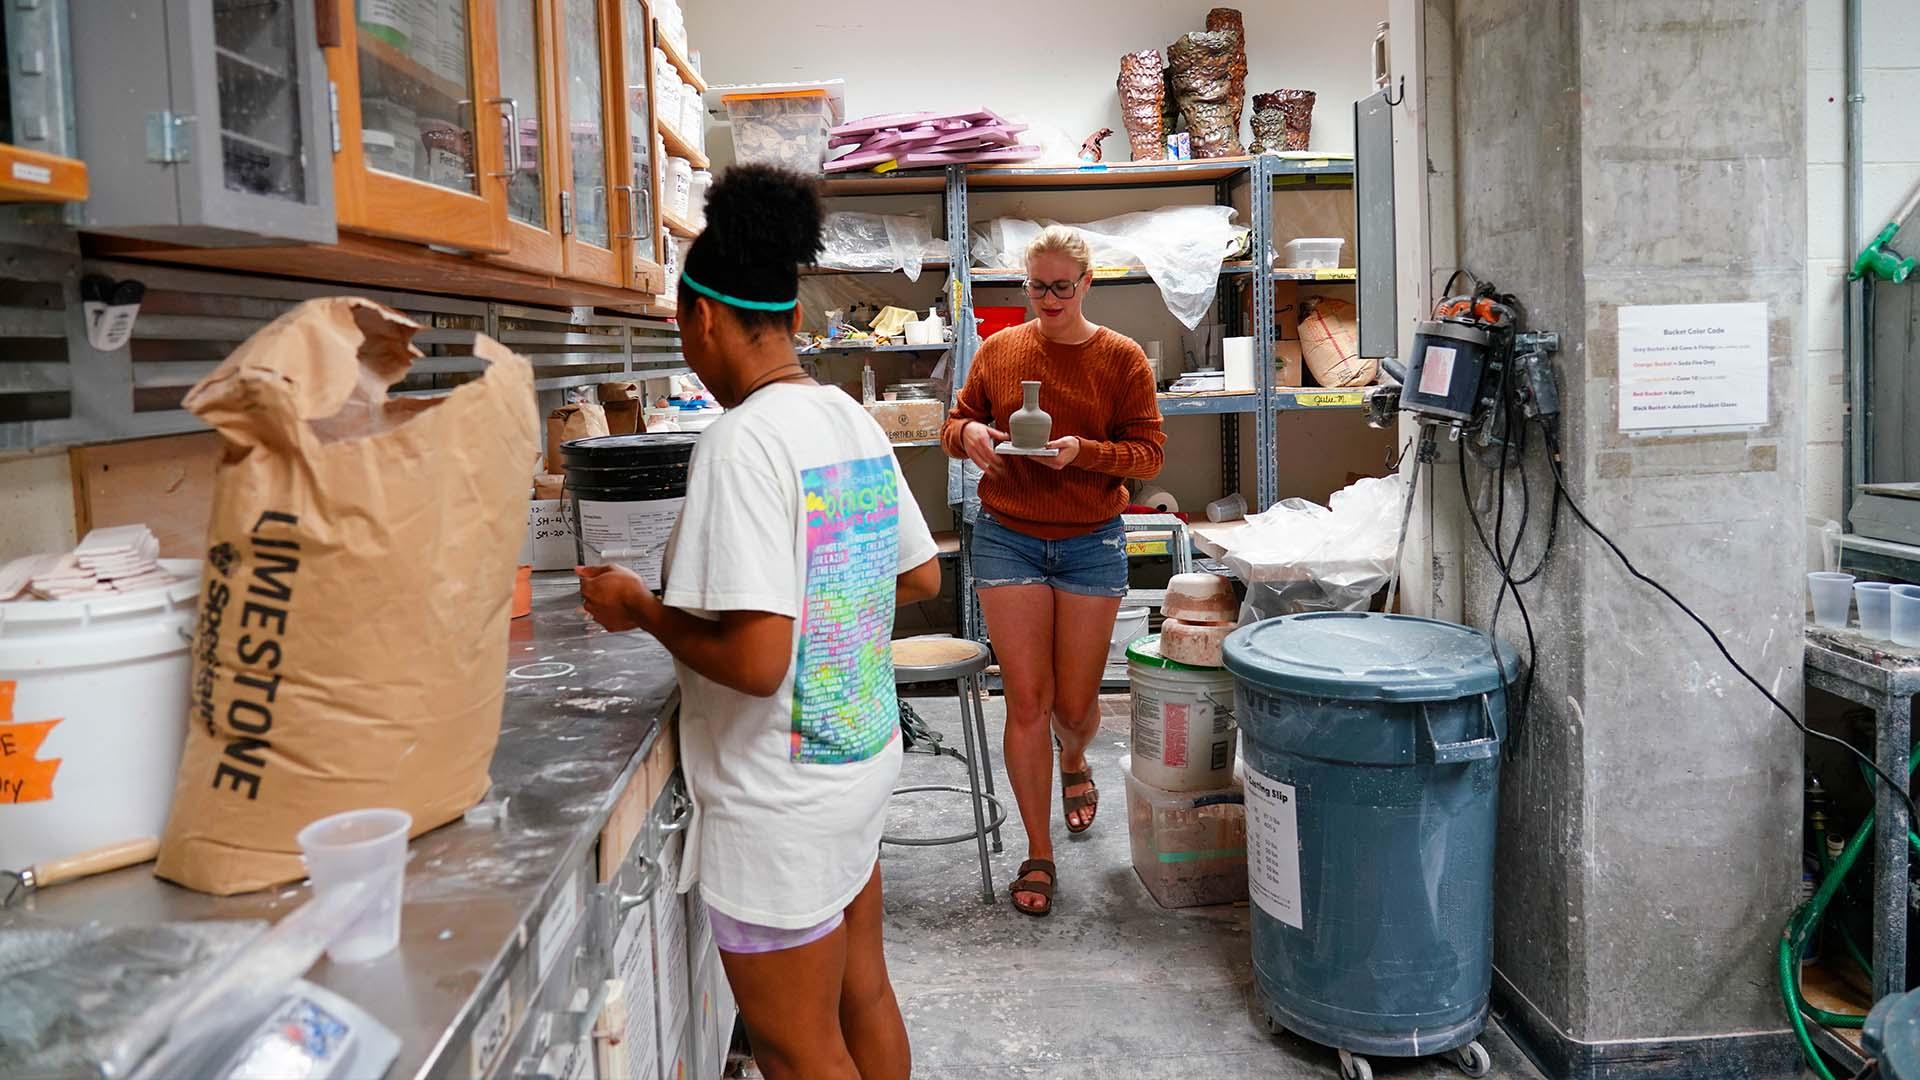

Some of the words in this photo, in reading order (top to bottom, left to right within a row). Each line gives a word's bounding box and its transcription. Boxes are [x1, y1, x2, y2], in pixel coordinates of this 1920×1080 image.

[1664, 328, 1686, 336] Bucket
[1314, 395, 1334, 406] Julie
[915, 430, 928, 438] RED
[211, 510, 301, 801] LIMESTONE
[1248, 775, 1271, 798] Casting
[1271, 789, 1289, 804] Slip
